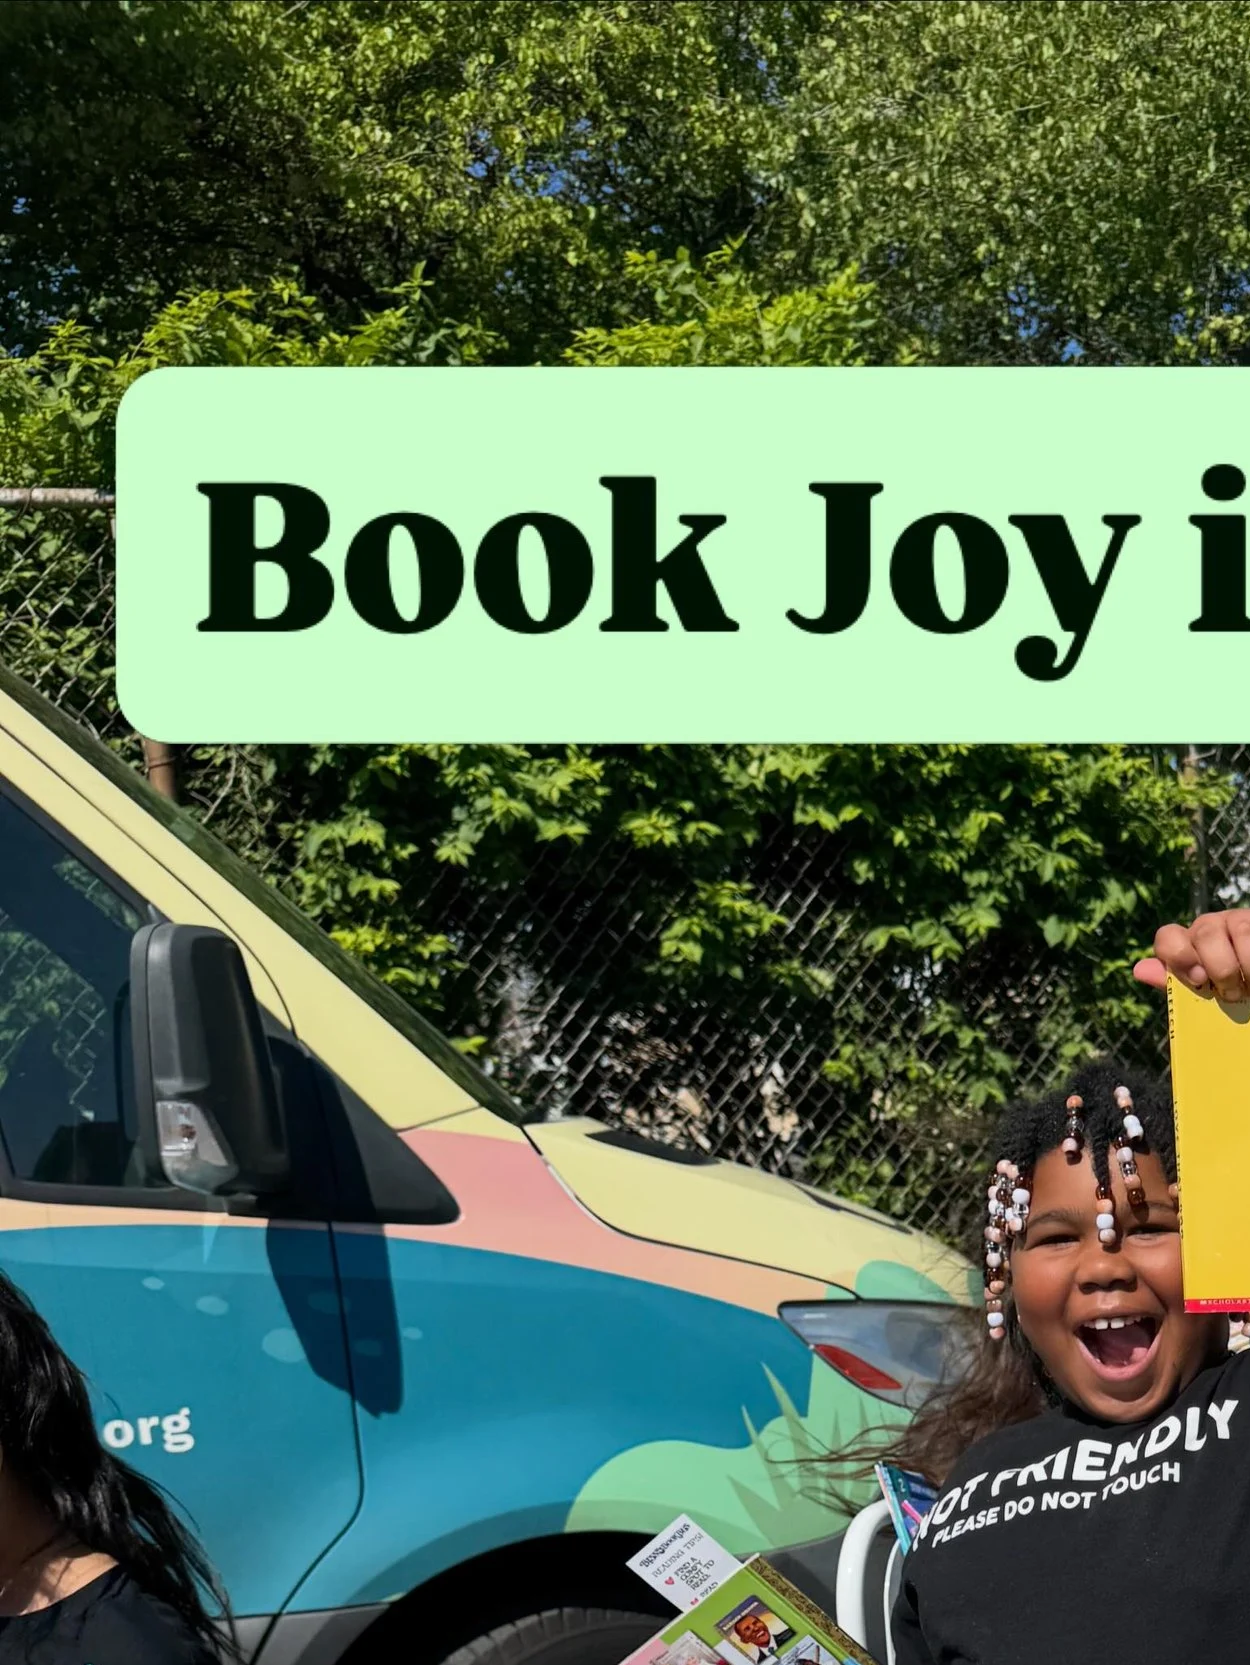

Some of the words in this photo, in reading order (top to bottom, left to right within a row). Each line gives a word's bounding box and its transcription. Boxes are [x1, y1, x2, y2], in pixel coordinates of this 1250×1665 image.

[103, 1406, 196, 1454] org
[912, 1471, 990, 1552] NOT
[990, 1399, 1240, 1498] FRIENDLY
[931, 1505, 1000, 1549] PLEASE
[1004, 1495, 1035, 1522] DO
[1044, 1491, 1098, 1511] NOT
[1102, 1461, 1181, 1503] TOUCH
[652, 1549, 685, 1578] READING
